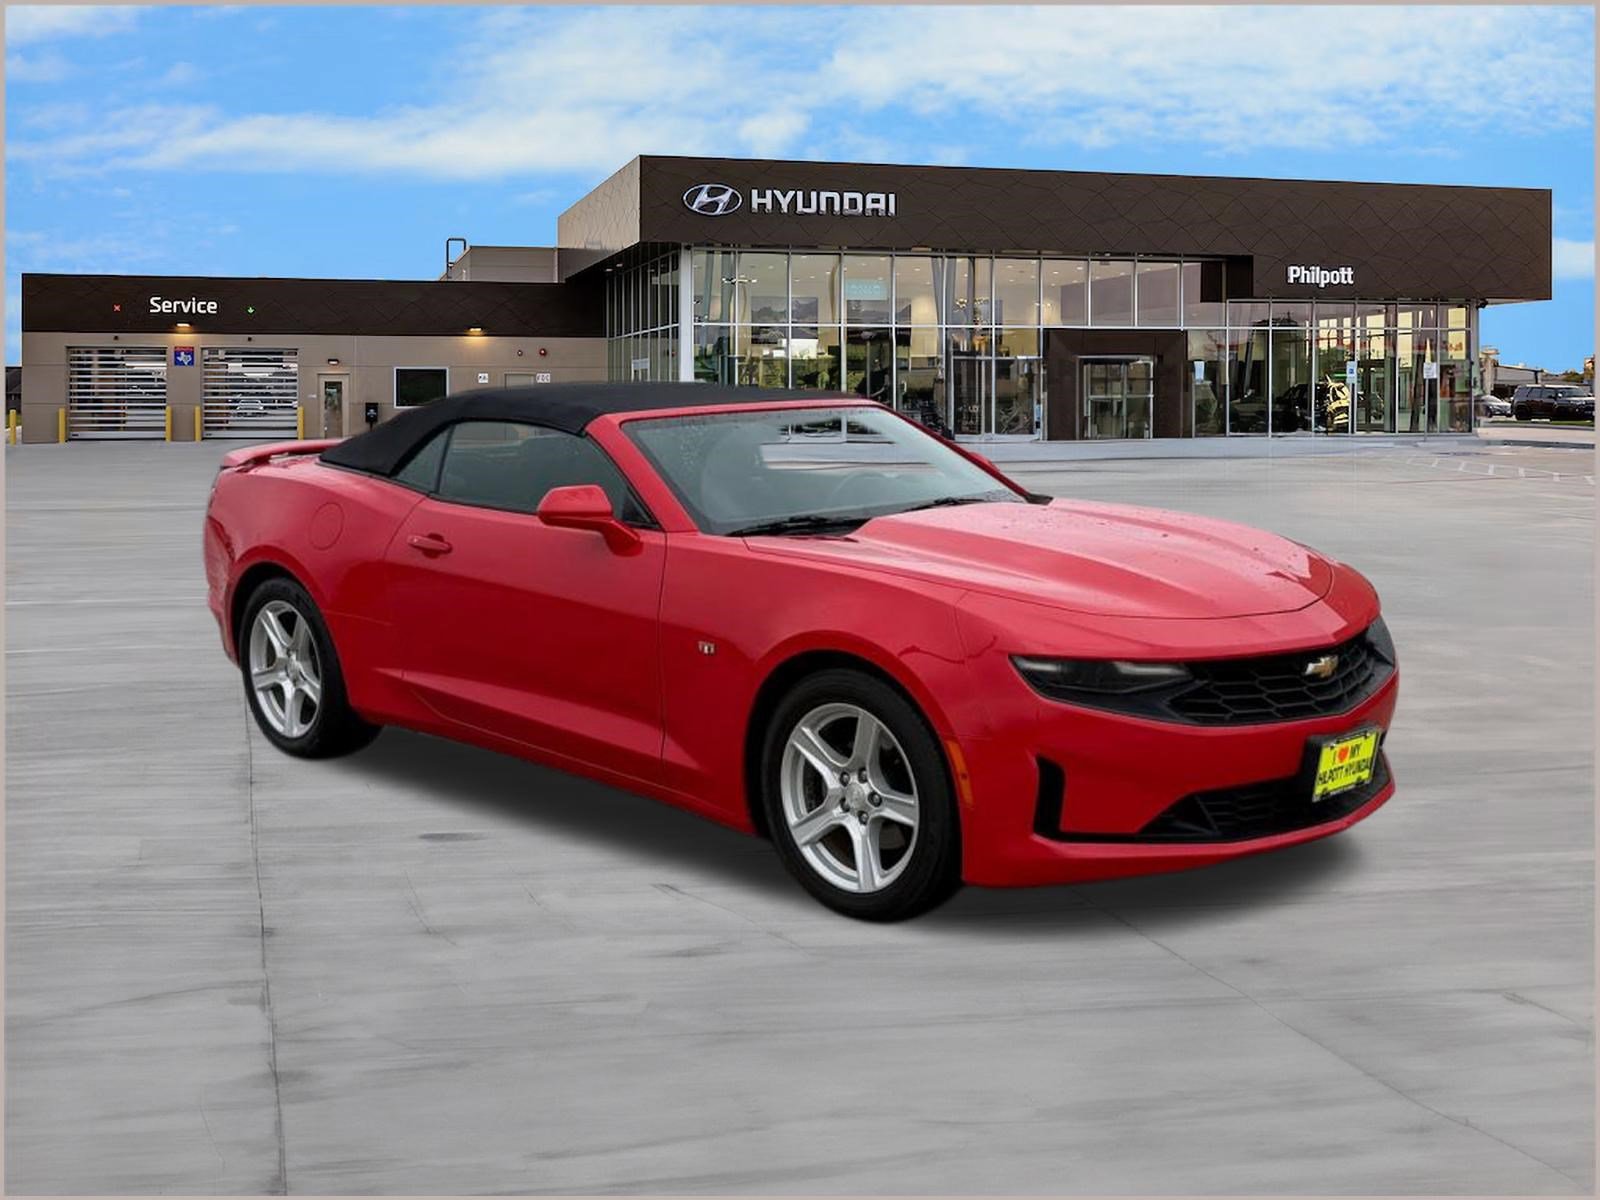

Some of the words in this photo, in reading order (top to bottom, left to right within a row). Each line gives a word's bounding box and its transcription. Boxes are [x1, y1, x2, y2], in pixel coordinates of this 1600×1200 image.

[751, 189, 896, 216] HYUNDAI
[1287, 266, 1354, 288] Philpott
[149, 297, 218, 315] Service
